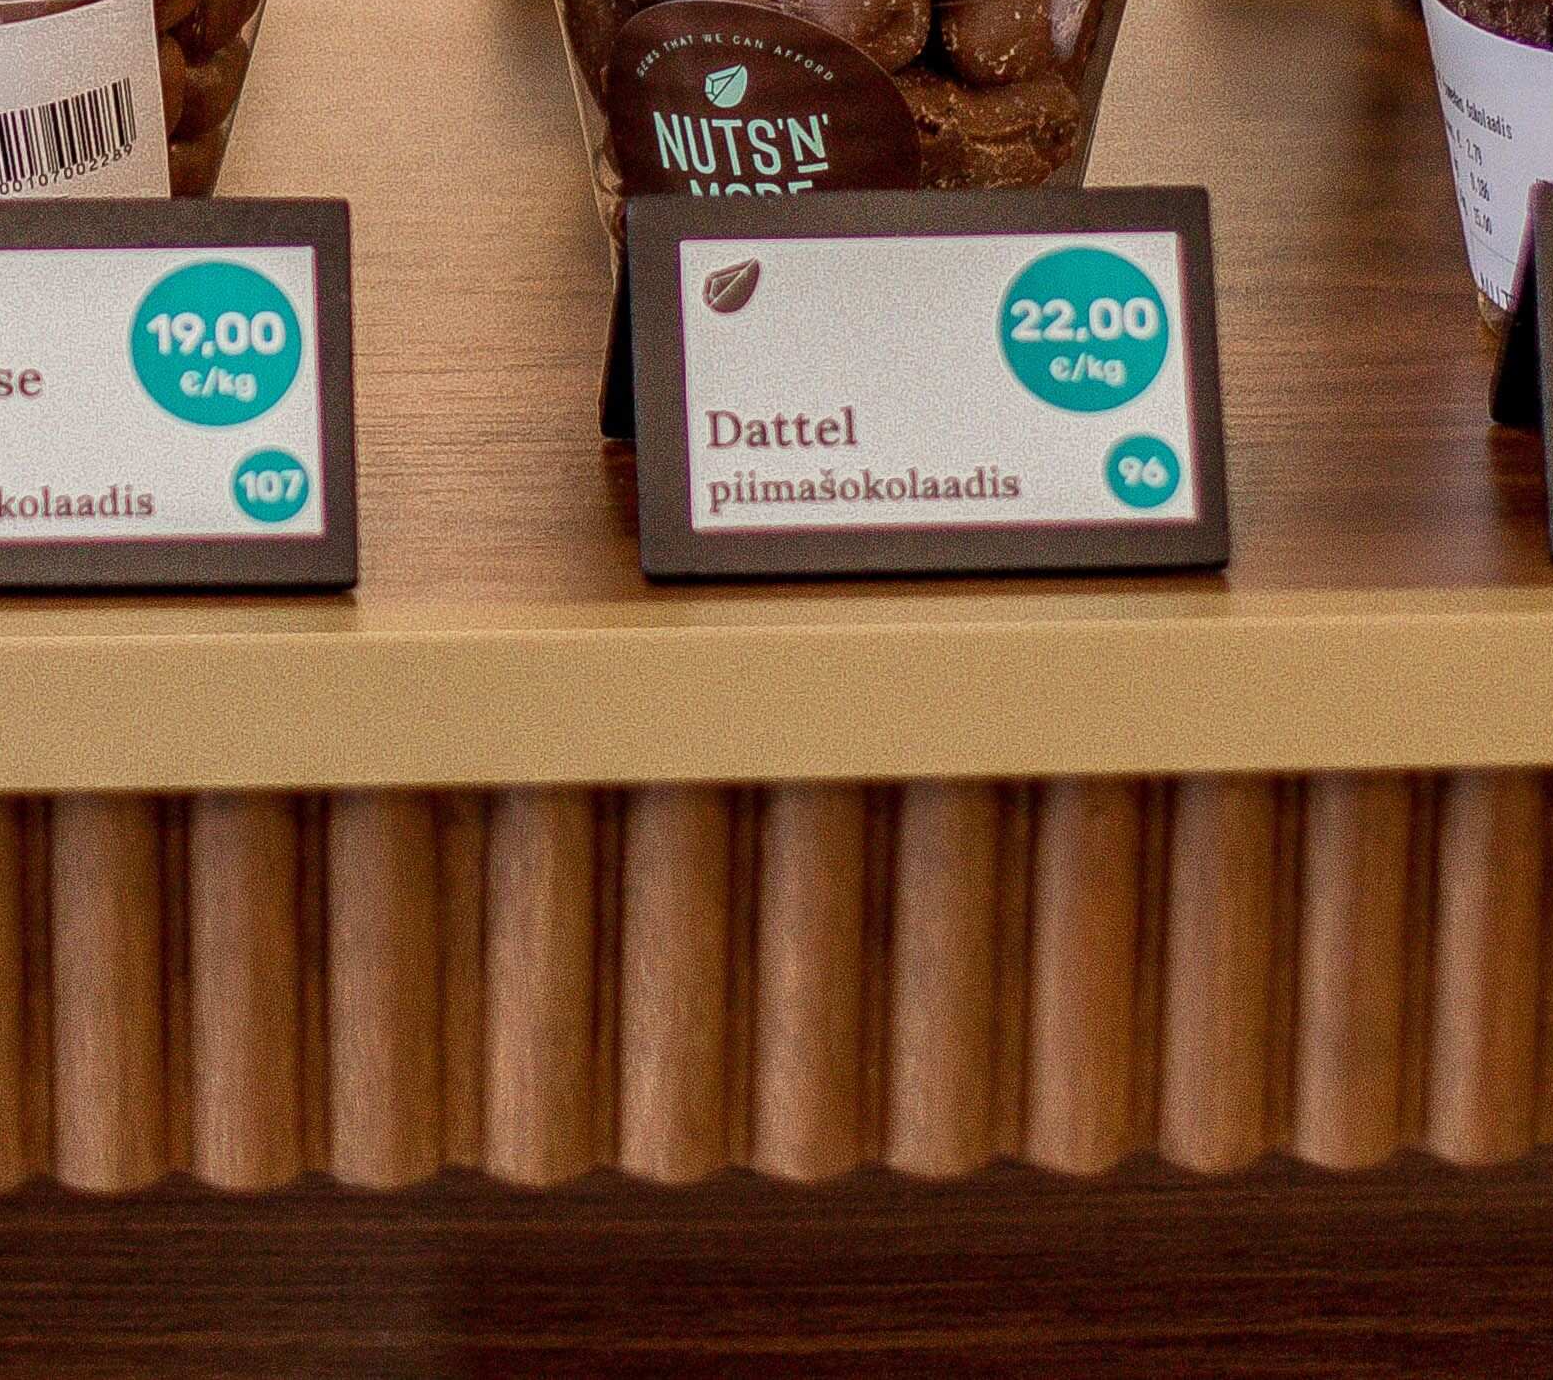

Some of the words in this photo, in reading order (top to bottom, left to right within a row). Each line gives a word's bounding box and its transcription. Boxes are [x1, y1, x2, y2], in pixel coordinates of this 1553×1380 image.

[653, 111, 830, 177] NUTS'N'
[179, 366, 258, 402] €/kg
[1049, 353, 1126, 387] €/kg
[705, 405, 858, 450] Dattel
[237, 468, 304, 502] 107
[708, 465, 1022, 515] piimašokolaadis
[1116, 456, 1169, 488] 96
